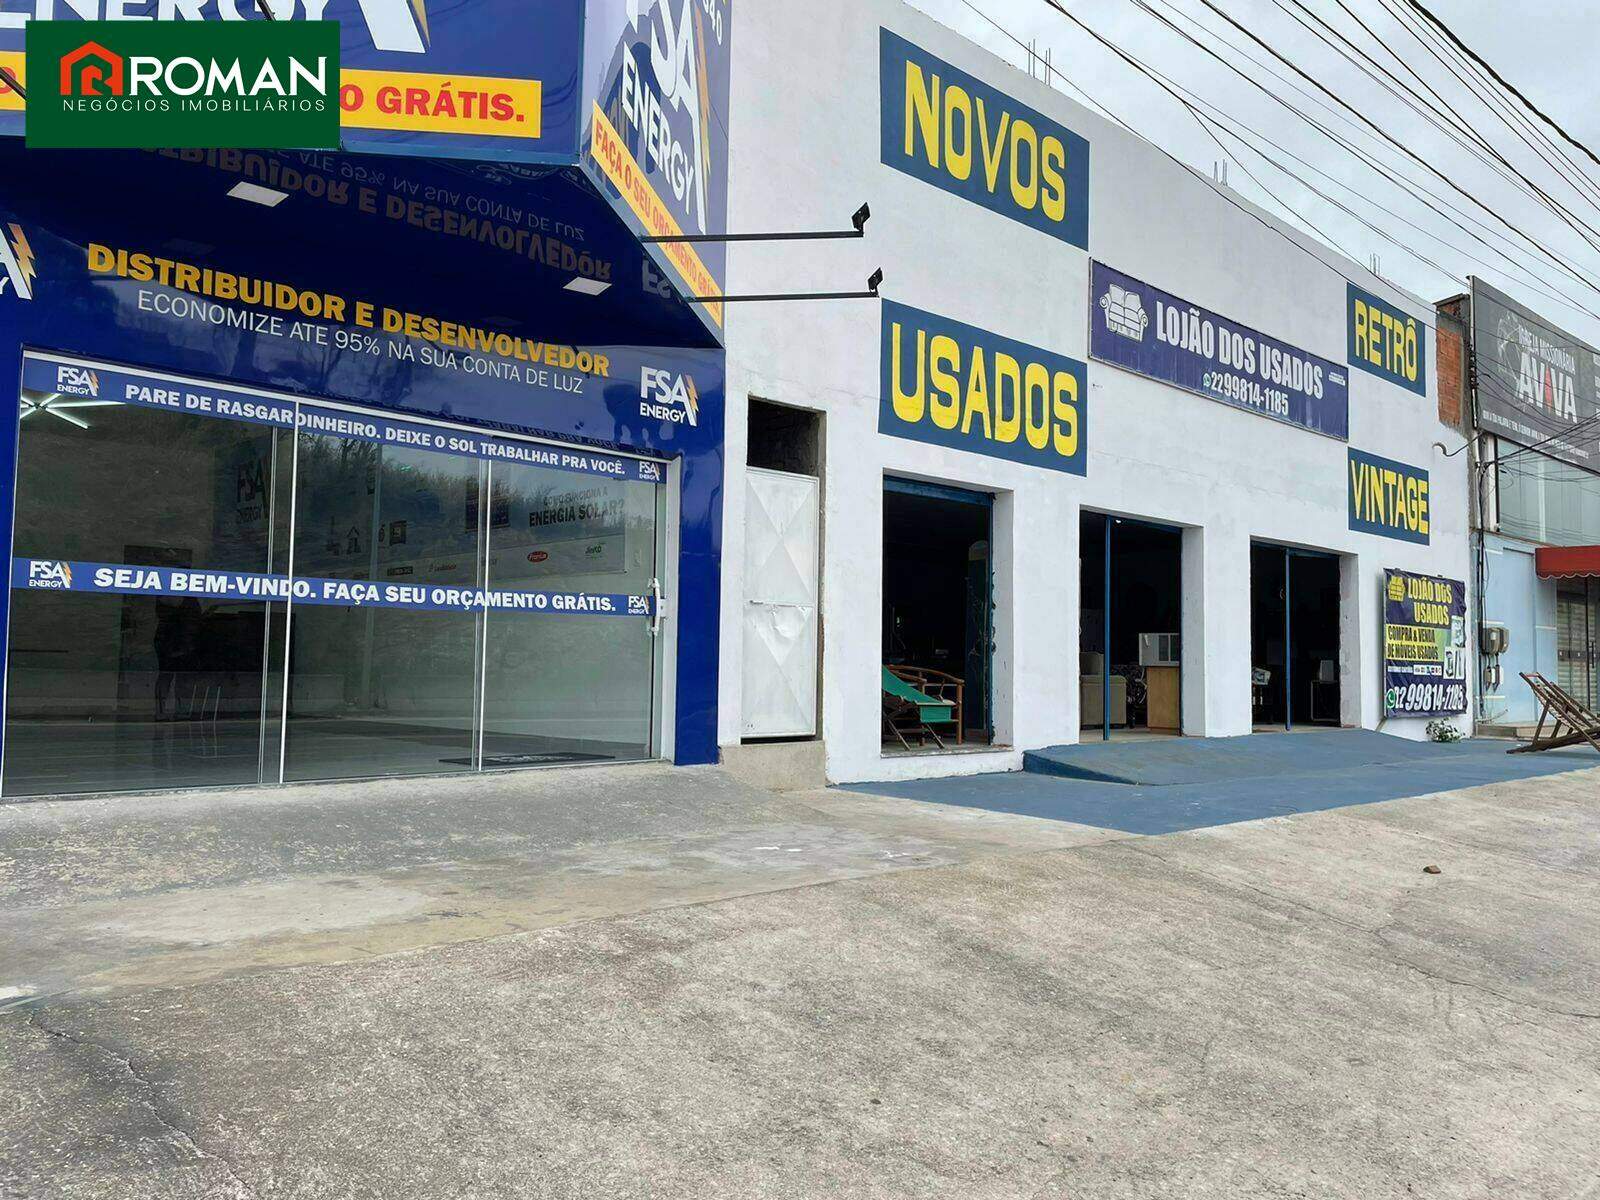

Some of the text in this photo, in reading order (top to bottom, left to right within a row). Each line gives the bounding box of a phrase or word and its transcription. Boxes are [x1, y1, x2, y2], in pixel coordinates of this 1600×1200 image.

[376, 81, 525, 122] GRÁTIS.
[620, 41, 695, 215] ENERGY
[904, 59, 1066, 223] NOVOS
[595, 119, 622, 179] FAÇA
[625, 164, 631, 190] O
[633, 177, 651, 218] SEU
[88, 243, 346, 322] DISTRIBUIDOR
[355, 301, 374, 328] E
[382, 307, 610, 378] DESENVOLVEDOR
[138, 290, 584, 394] ECONOMIZE ATE 95% NA SUA CONTA DE LUZ
[1156, 301, 1324, 400] LOJÃO DOS USADOS
[1354, 298, 1417, 382] RETRÔ
[57, 366, 98, 396] FSA
[57, 384, 89, 396] ENERGY
[640, 366, 697, 427] FSA
[892, 321, 1078, 458] USADOS
[125, 384, 180, 407] PARE
[185, 392, 212, 412] DE
[217, 398, 294, 425] RASGAR
[296, 411, 382, 439] DINHEIRO.
[386, 426, 431, 447] DEIXE
[434, 434, 447, 449] O
[448, 437, 477, 454] SOL
[480, 442, 559, 466] TRABALHAR
[562, 453, 588, 470] PRA
[591, 458, 626, 475] VOCÊ.
[640, 406, 687, 425] ENERGY
[529, 506, 576, 528] ENERGIA
[1351, 459, 1429, 535] VINTAGE
[28, 579, 63, 589] ENERGY
[29, 560, 70, 589] FSA
[94, 567, 616, 612] SEJA BEM-VINDO. FAÇA SEU ORÇAMENTO GRÁTIS.
[1407, 577, 1433, 602] LOJÃO
[628, 595, 649, 615] FSA
[1414, 602, 1450, 626] USADOS
[1387, 642, 1439, 660] DE MÓVEIS USADOS
[1388, 626, 1412, 642] COMPRA
[1418, 628, 1435, 643] VENDA
